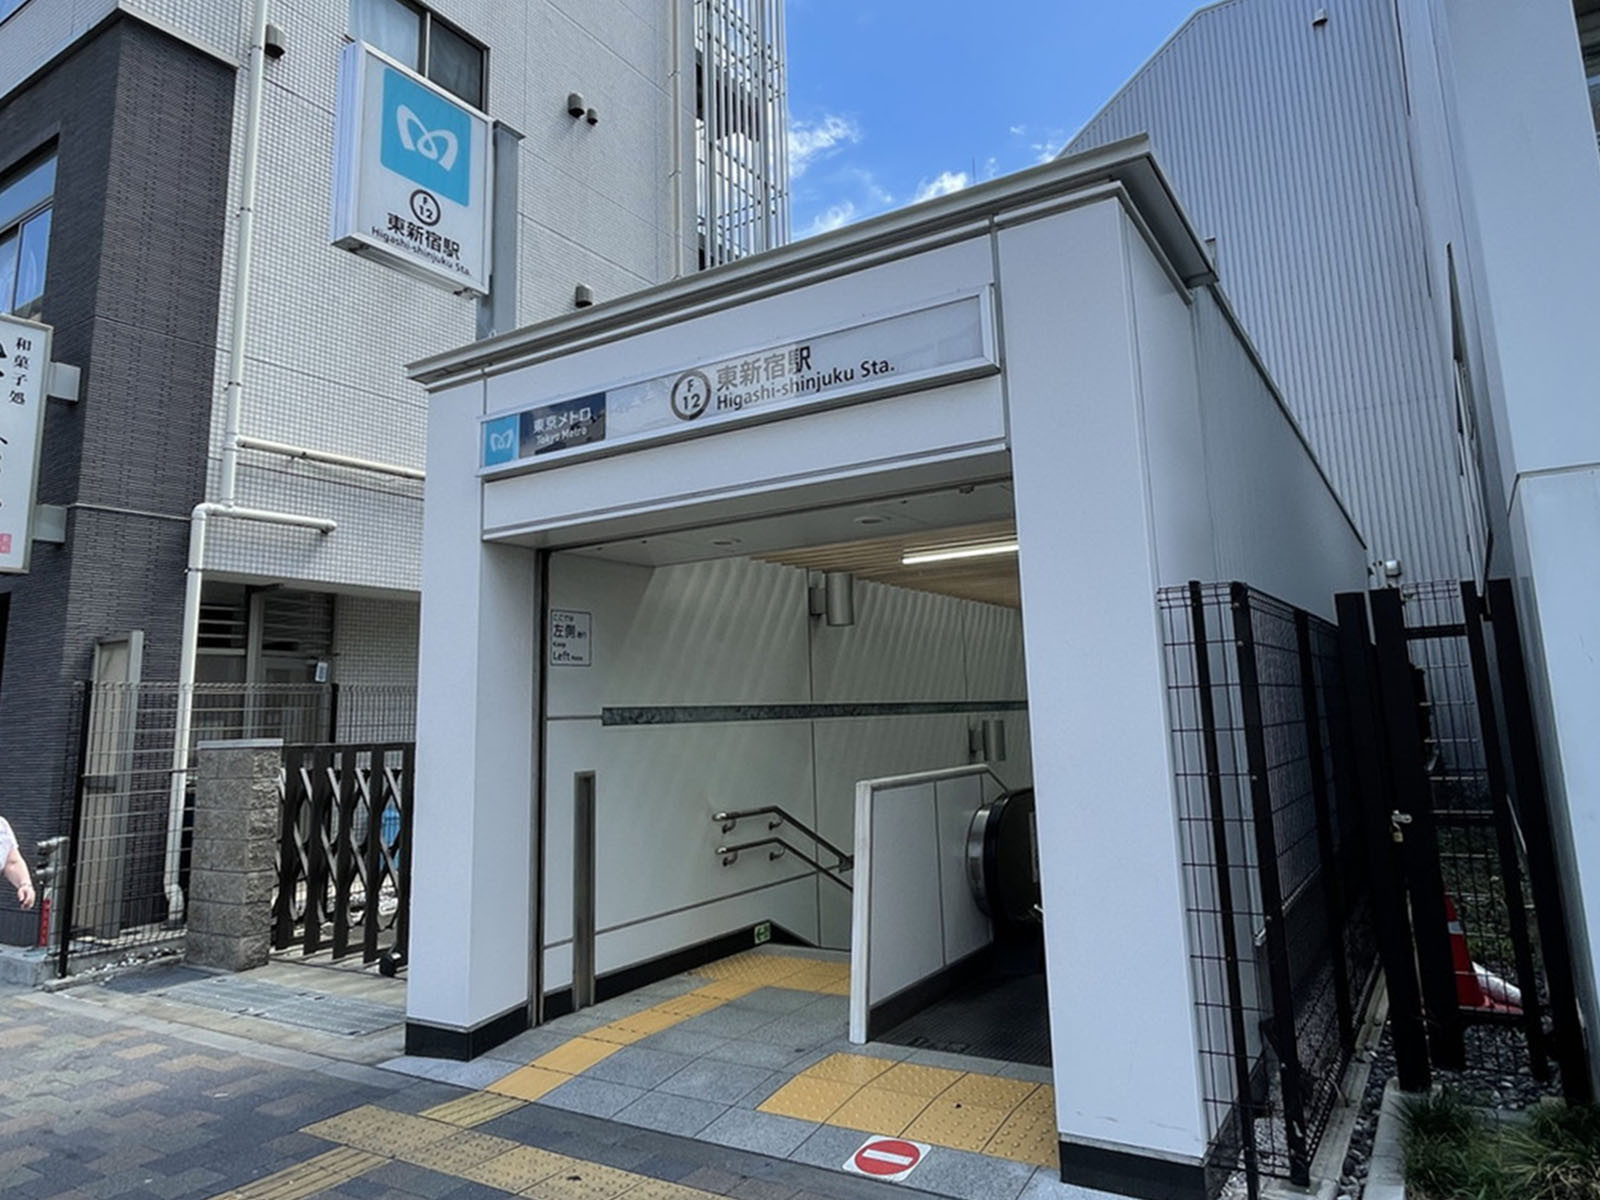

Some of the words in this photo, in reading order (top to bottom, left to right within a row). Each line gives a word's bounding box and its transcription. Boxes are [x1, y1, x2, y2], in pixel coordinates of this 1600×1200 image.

[419, 204, 433, 220] 12
[387, 212, 460, 261] 東新宿駅
[716, 345, 812, 392] 東新宿駅
[687, 379, 695, 392] F
[716, 366, 854, 411] Higashi-shinjuku
[860, 359, 895, 378] Sta.
[683, 393, 700, 410] 12
[533, 407, 592, 433] 東京メトロ
[561, 426, 588, 440] Metro
